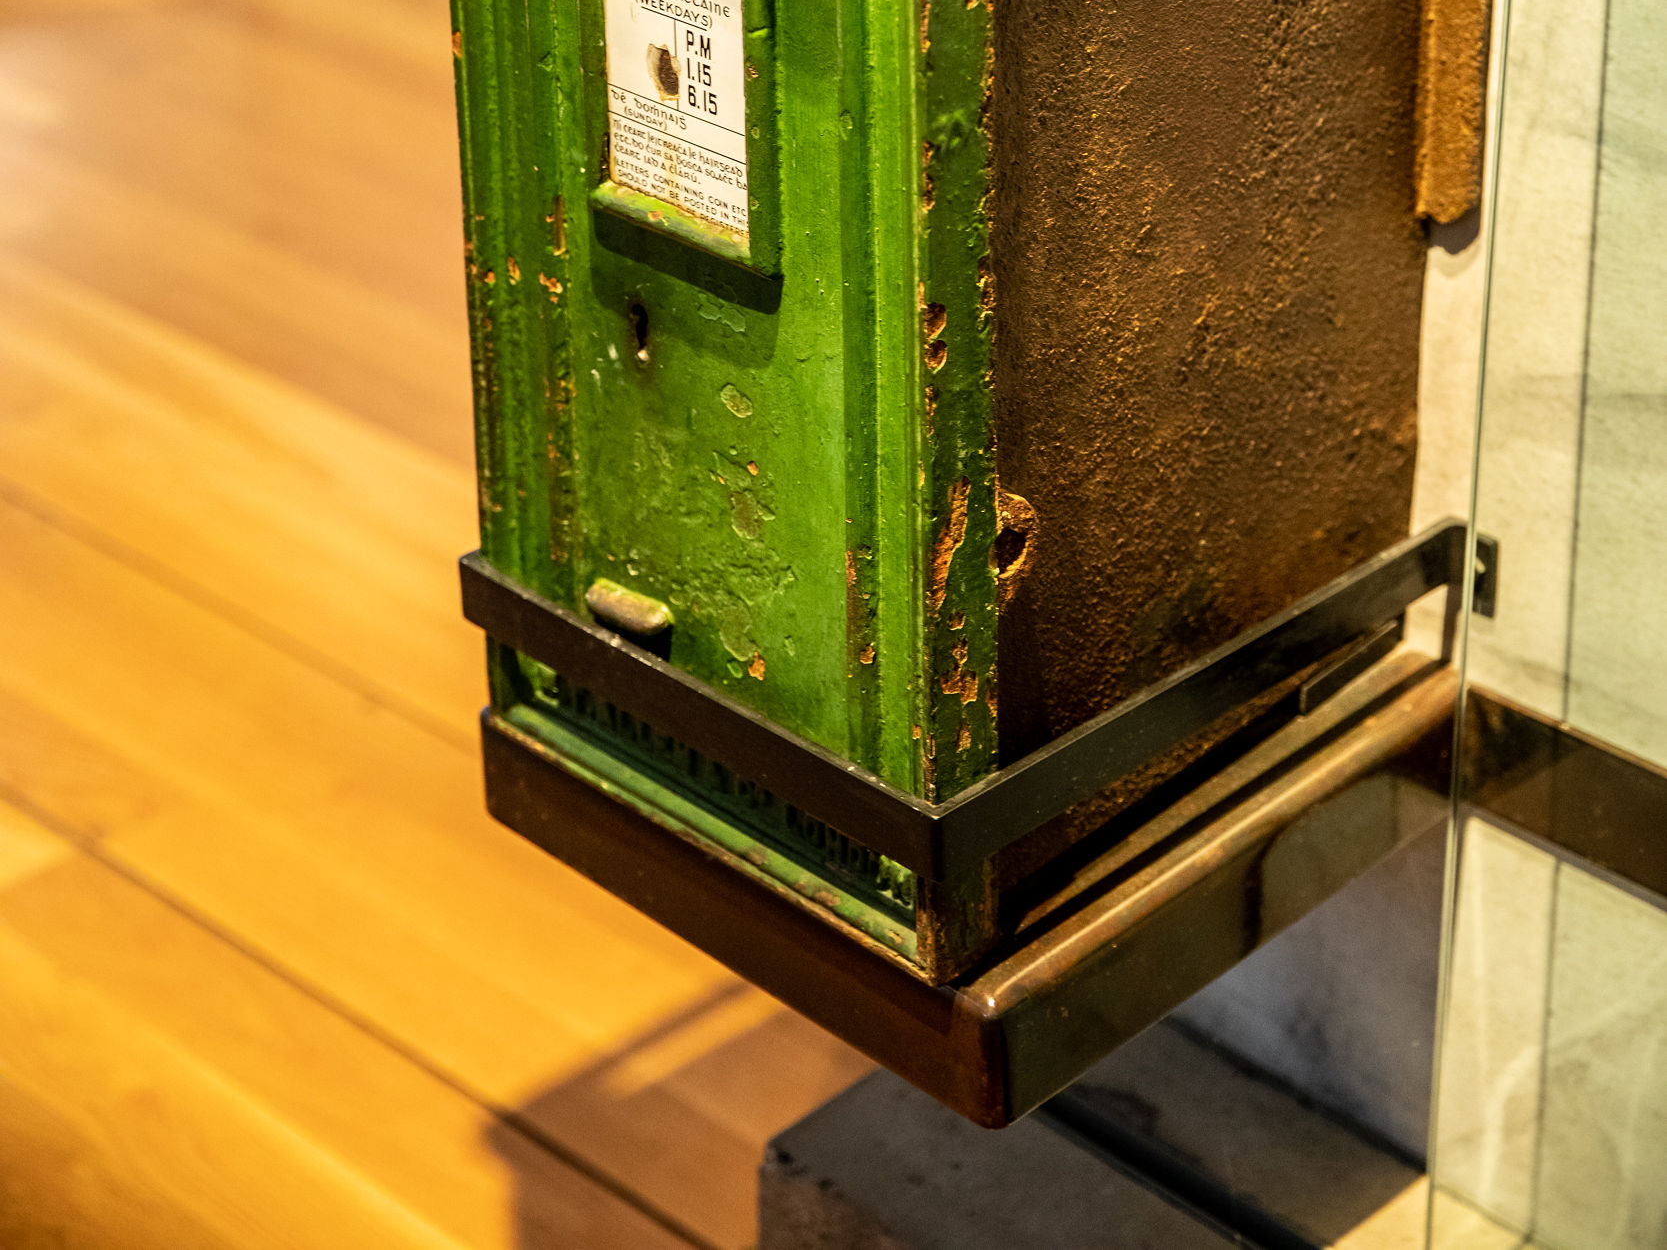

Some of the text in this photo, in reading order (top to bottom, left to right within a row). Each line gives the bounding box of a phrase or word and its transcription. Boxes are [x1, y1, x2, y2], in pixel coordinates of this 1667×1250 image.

[687, 57, 712, 87] 1.15
[688, 84, 718, 116] 6.15
[624, 105, 667, 131] (SUNDAY)
[653, 173, 704, 200] CONTAINING
[708, 195, 728, 210] COIN
[684, 196, 717, 215] POSTED
